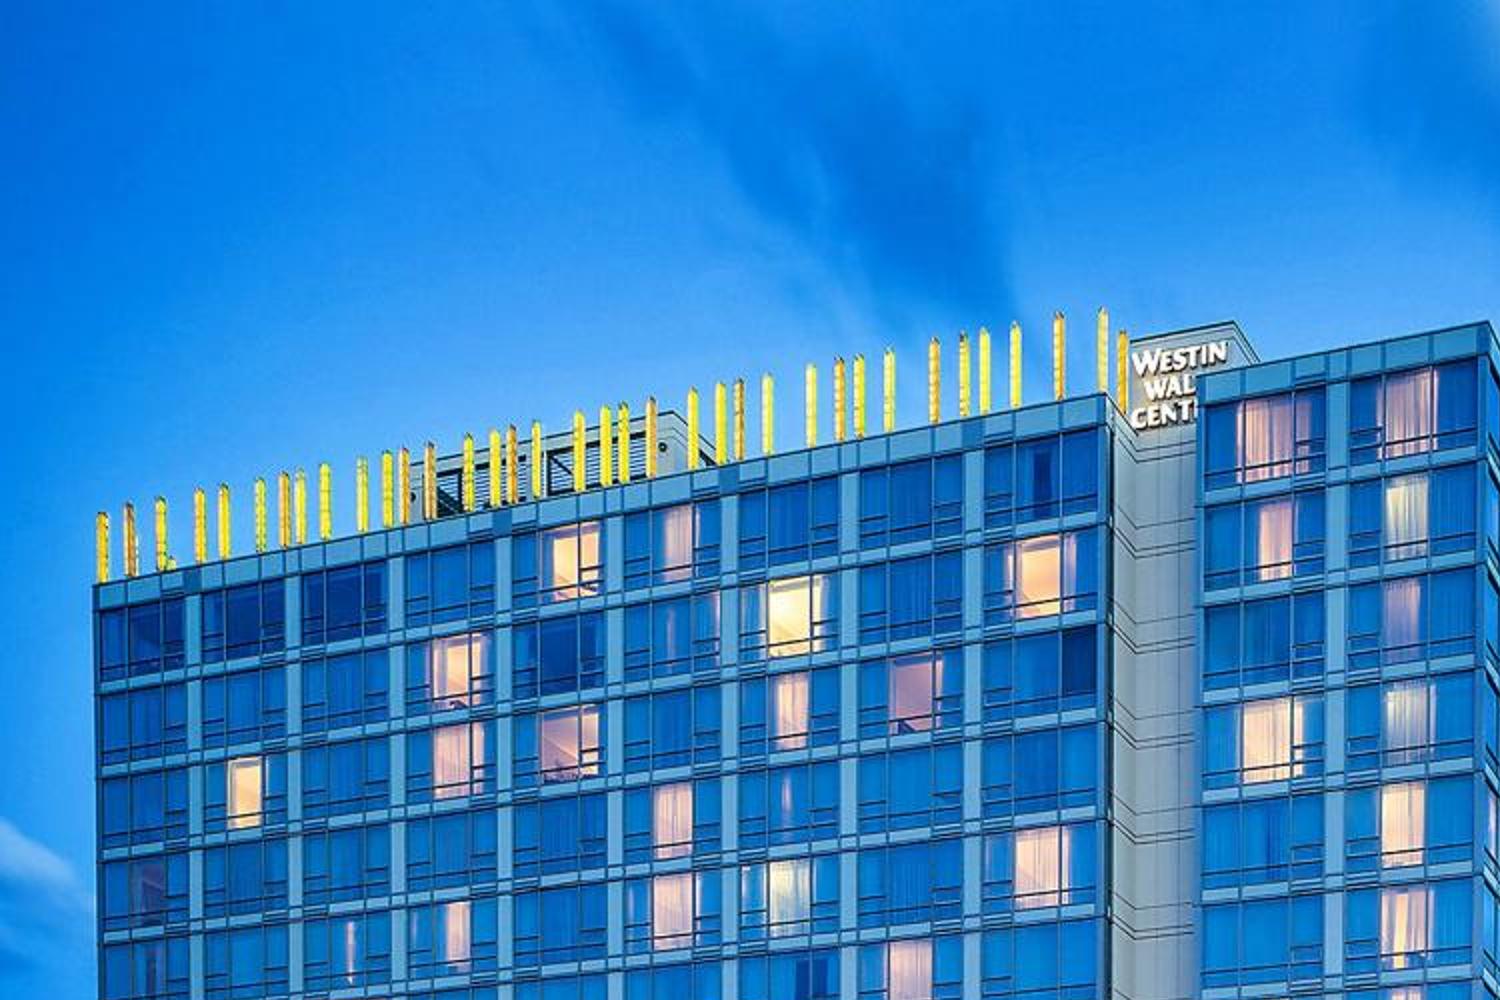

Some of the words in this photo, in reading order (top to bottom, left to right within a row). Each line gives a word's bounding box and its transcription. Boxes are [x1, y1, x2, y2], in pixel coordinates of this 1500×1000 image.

[1132, 342, 1227, 375] WESTIN
[1144, 374, 1197, 400] WAL
[1131, 400, 1198, 429] CENT
